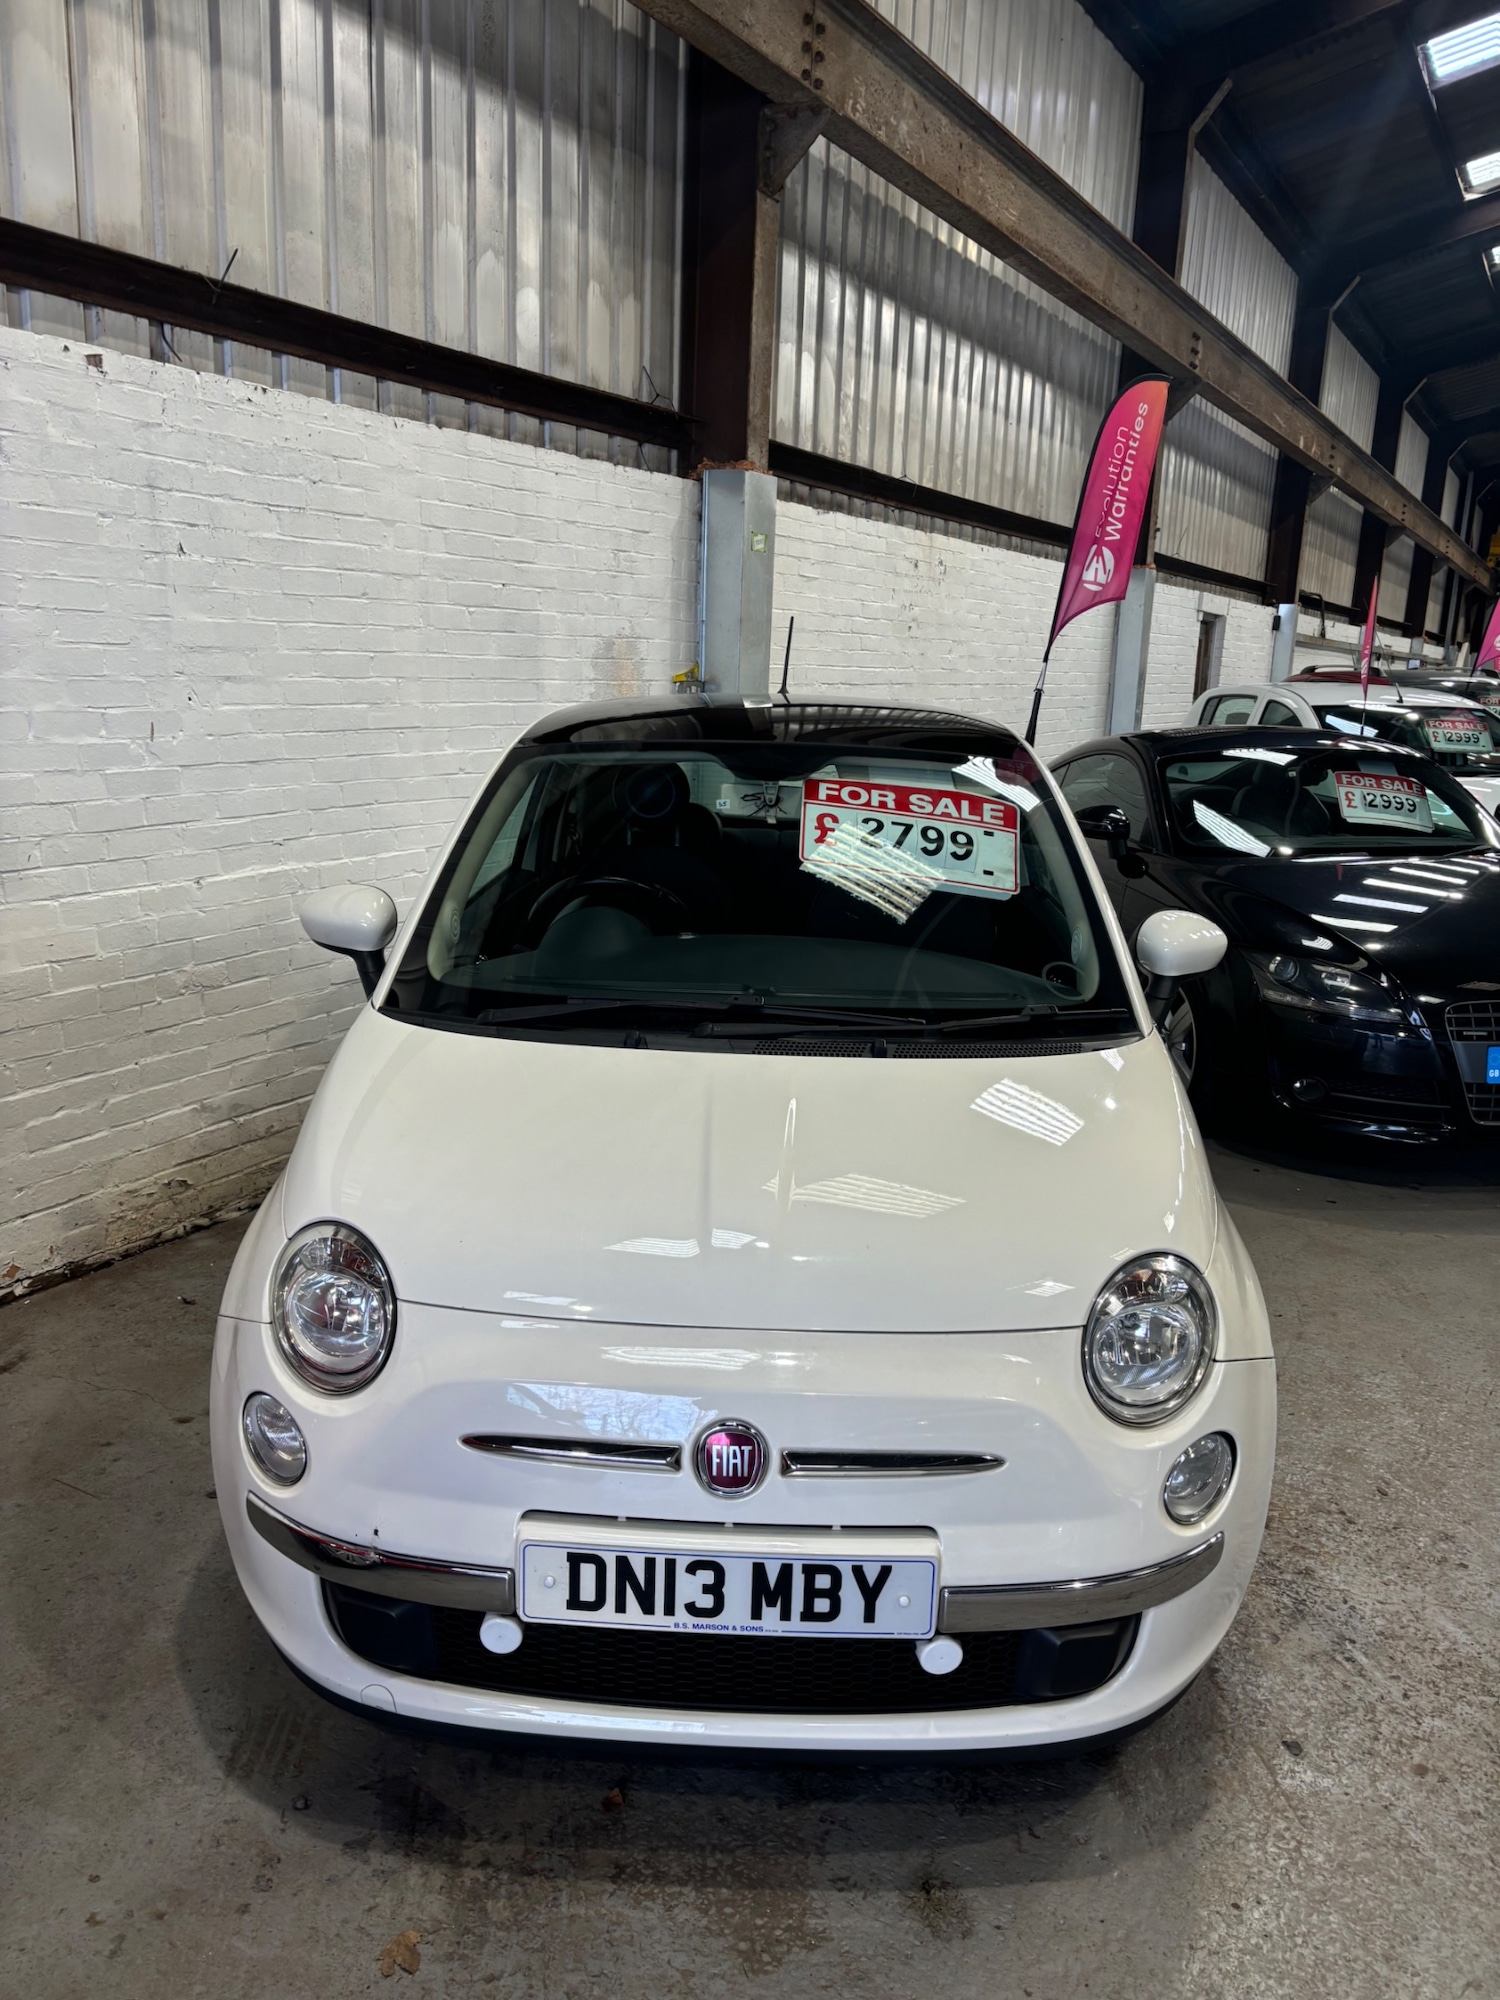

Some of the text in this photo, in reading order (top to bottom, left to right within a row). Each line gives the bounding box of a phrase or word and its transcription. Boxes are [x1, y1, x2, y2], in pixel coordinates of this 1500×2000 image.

[1104, 402, 1149, 542] Warranties
[1429, 719, 1484, 731] FOR SALE
[1341, 774, 1422, 795] FOR SALE
[818, 782, 1005, 826] FOR SALE
[861, 816, 975, 861] 2799
[1488, 1069, 1500, 1078] GB
[711, 1444, 753, 1478] FIAT
[566, 1551, 893, 1624] DN13 MBY
[673, 1622, 690, 1630] B.S.
[692, 1623, 730, 1632] MARSON
[740, 1625, 764, 1633] SONS
